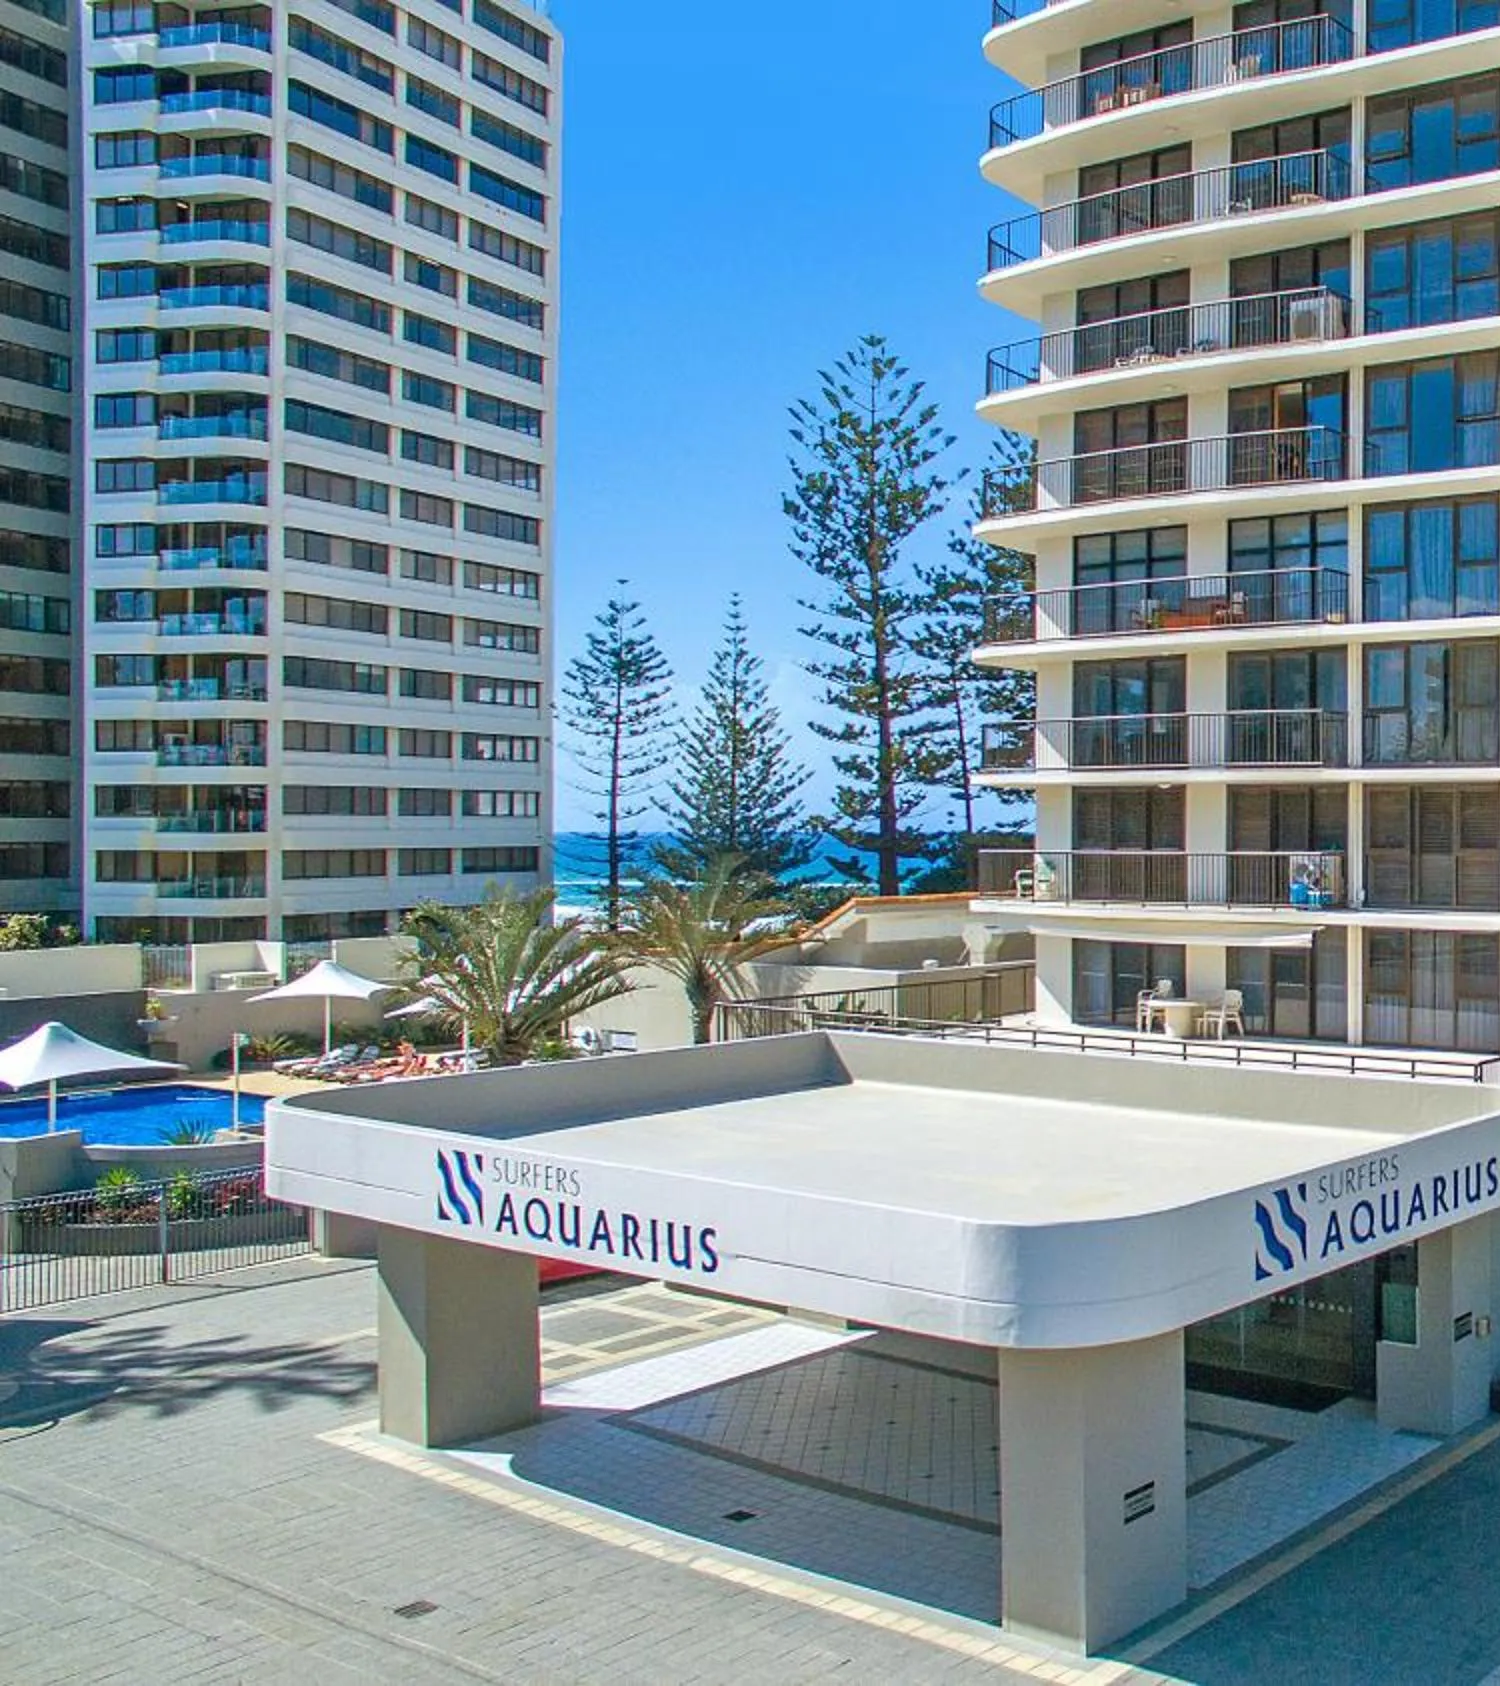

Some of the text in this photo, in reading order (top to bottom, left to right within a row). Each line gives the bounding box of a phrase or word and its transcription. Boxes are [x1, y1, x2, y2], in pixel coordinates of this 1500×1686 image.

[492, 1157, 580, 1197] SURFERS
[1318, 1154, 1400, 1203] SURFERS
[1320, 1157, 1499, 1258] AQUARIUS
[495, 1193, 718, 1272] AQUARIUS
